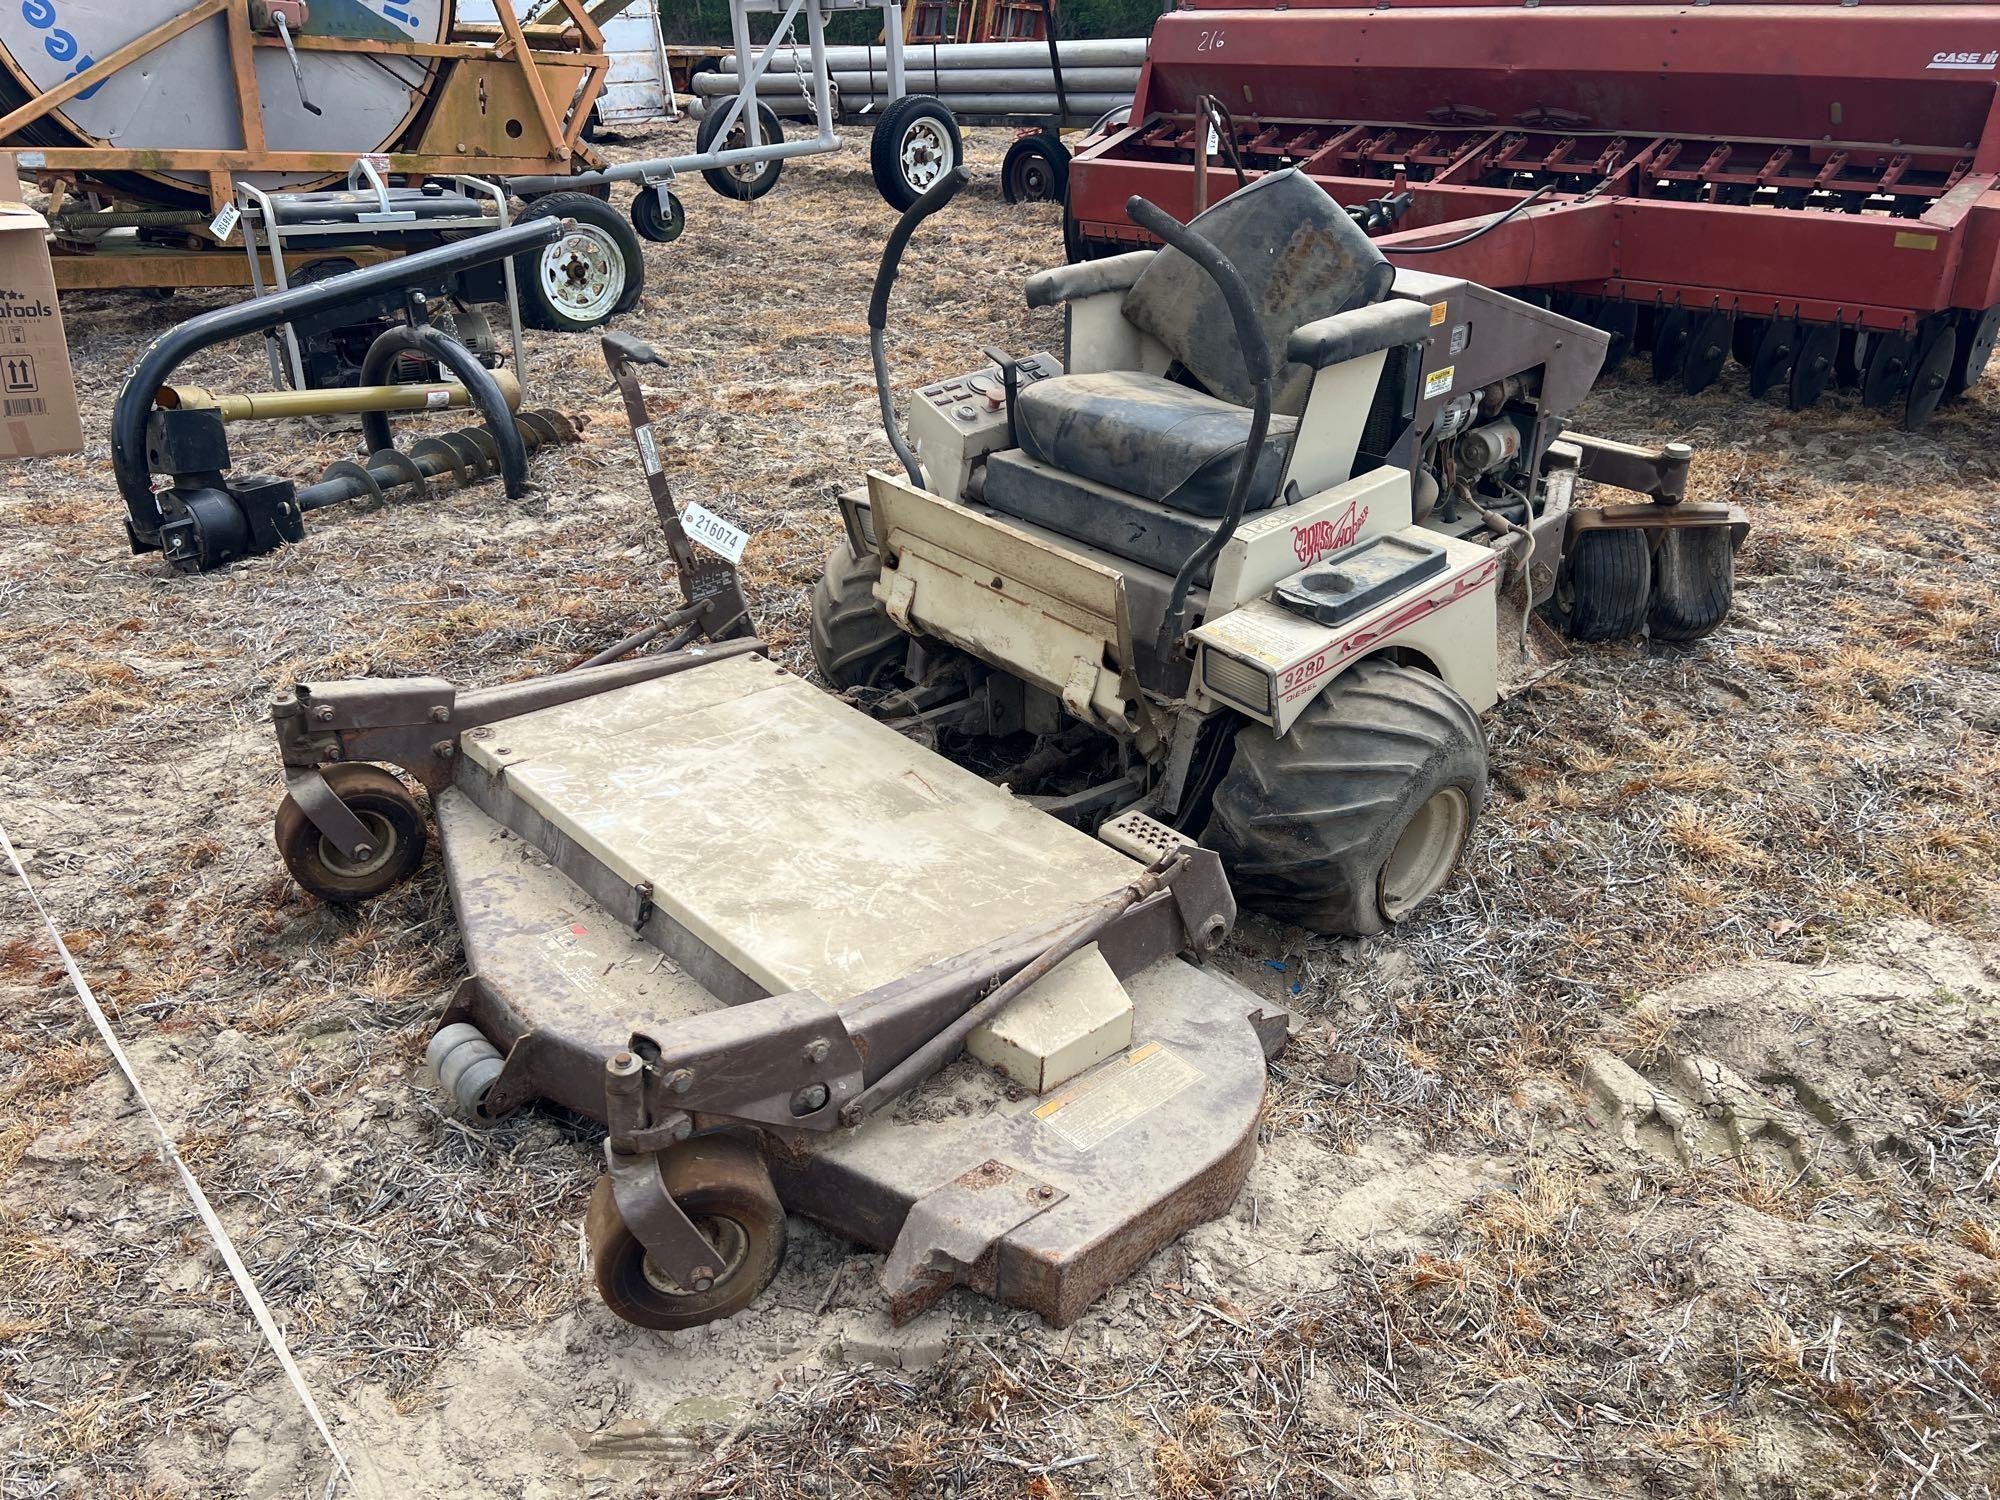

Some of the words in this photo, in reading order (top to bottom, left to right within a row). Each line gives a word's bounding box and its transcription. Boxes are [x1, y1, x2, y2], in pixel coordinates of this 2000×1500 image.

[1197, 31, 1225, 51] 216
[1933, 52, 1981, 63] CASE
[695, 514, 738, 549] 216074
[1284, 655, 1325, 689] 928D
[1286, 682, 1317, 703] DIESEL
